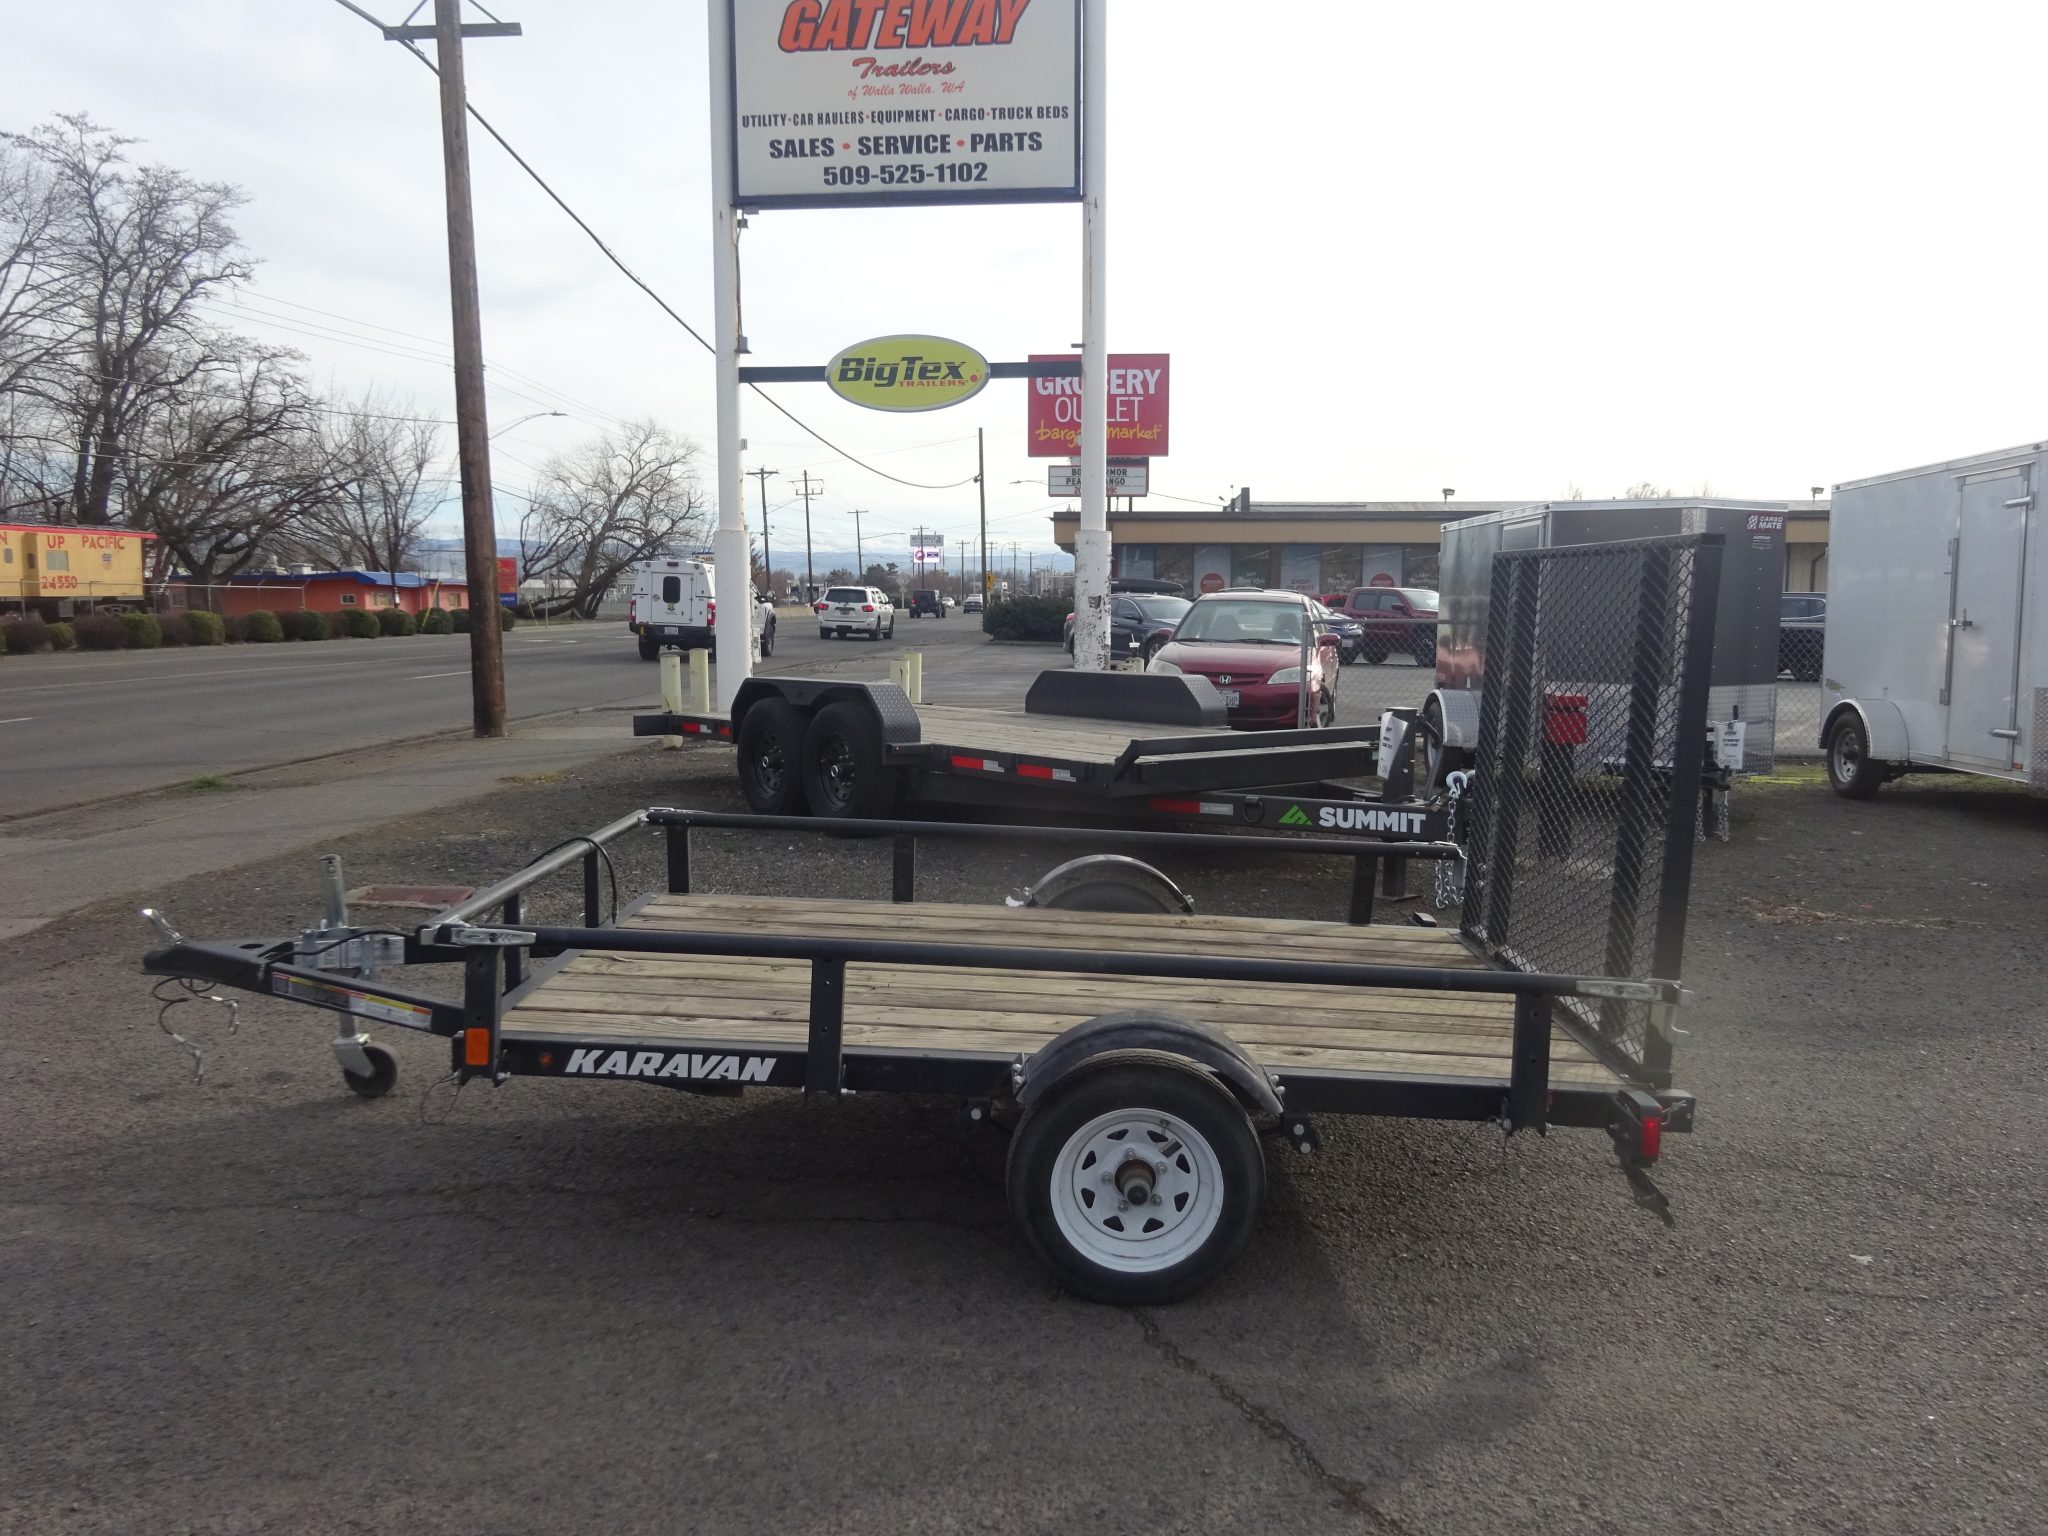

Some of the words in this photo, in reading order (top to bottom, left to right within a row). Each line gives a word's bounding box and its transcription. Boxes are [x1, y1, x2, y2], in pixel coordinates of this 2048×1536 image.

[778, 0, 1030, 53] GATEWAY
[852, 56, 956, 80] Trailers
[847, 87, 857, 100] of
[862, 83, 895, 97] Walla
[941, 81, 965, 93] WA
[742, 114, 787, 128] UTILITY
[793, 113, 814, 126] CAR
[817, 111, 864, 125] HAULERS
[871, 109, 936, 124] EQUIPMENT
[945, 107, 985, 121] CARGO
[991, 106, 1033, 120] TRUCK
[1037, 106, 1069, 119] BEDS
[769, 137, 835, 159] SALES
[858, 134, 951, 156] SERVICE
[970, 131, 1043, 153] PARTS
[823, 162, 988, 186] 509-525-1102
[899, 379, 966, 388] TRAILERS
[1036, 369, 1161, 396] GRERY
[1055, 397, 1144, 423] OUET
[1759, 521, 1782, 529] MATE
[47, 535, 65, 549] UP
[81, 534, 125, 550] PACIFIC
[1319, 806, 1426, 834] SUMMIT
[564, 1048, 777, 1082] KARAVAN
